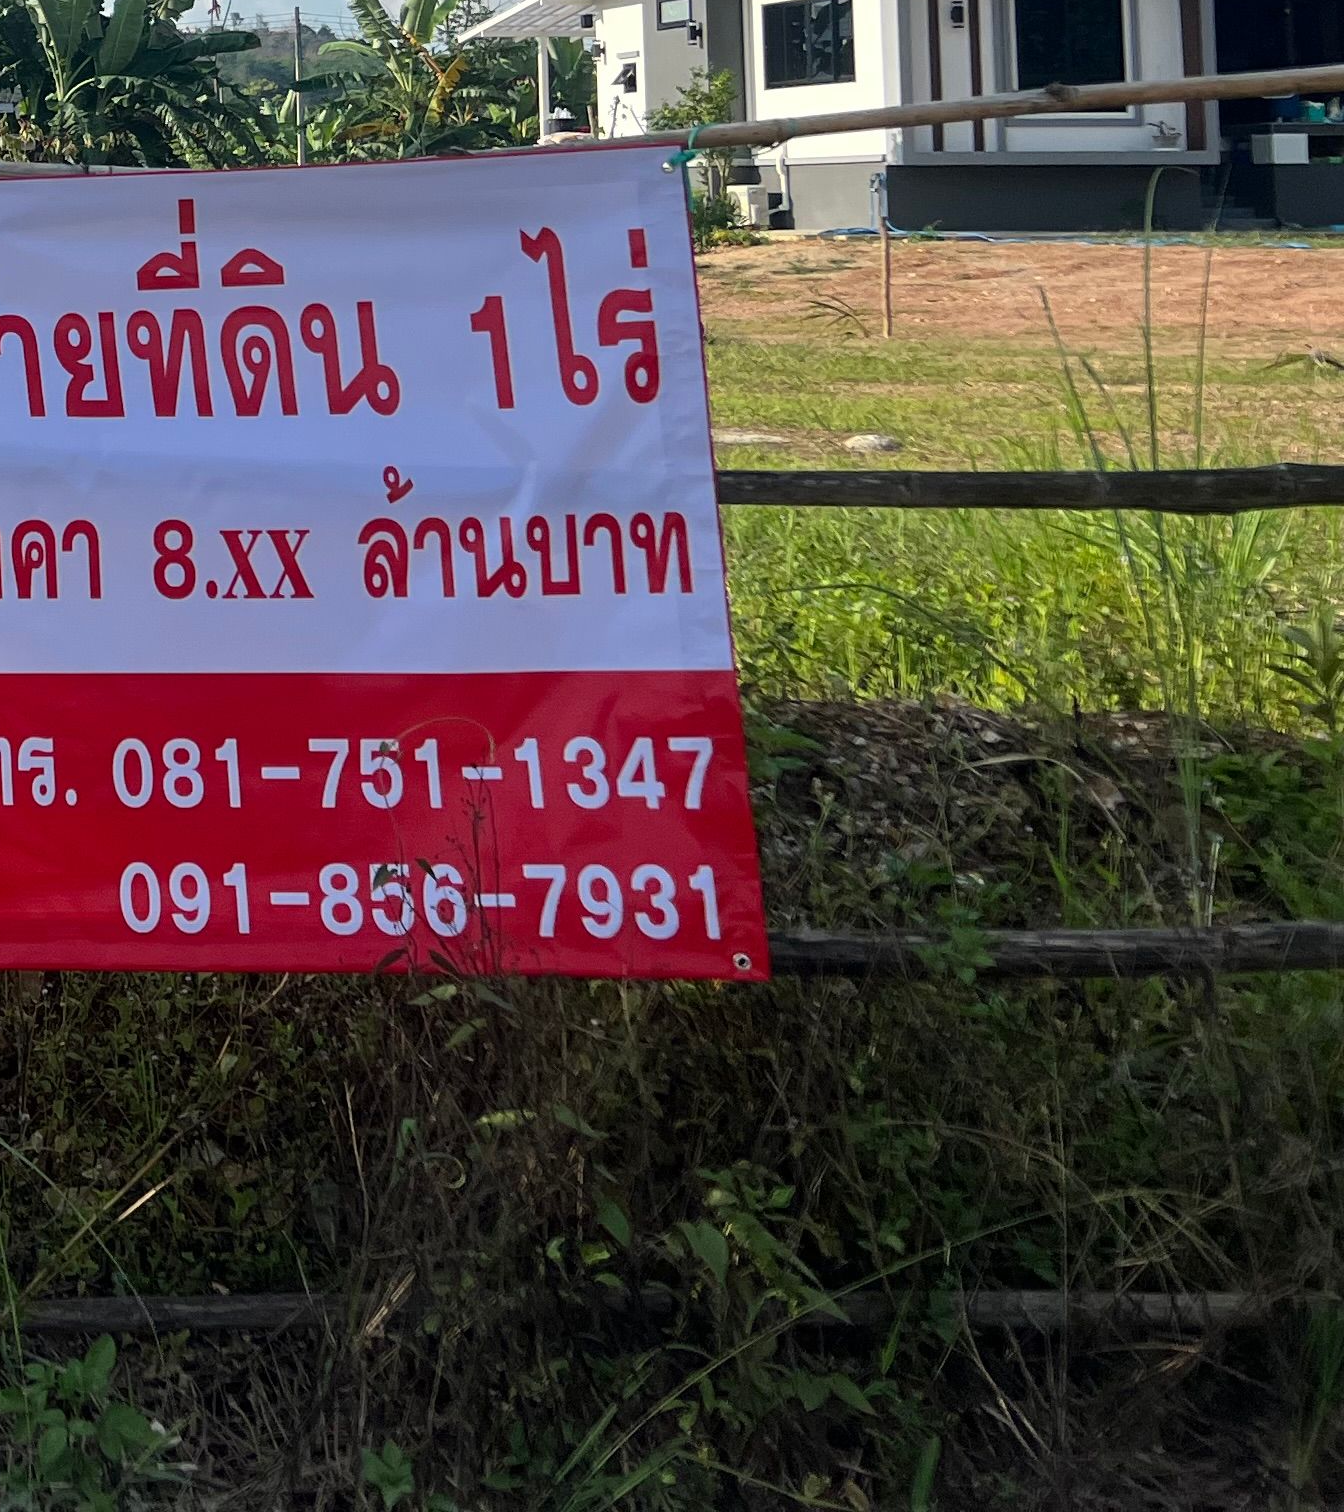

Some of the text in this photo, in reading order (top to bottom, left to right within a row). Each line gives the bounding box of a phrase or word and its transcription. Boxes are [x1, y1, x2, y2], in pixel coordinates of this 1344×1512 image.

[470, 226, 662, 411] 1ไร่
[358, 465, 693, 598] ล้านบาท
[113, 736, 714, 810] 081-751-1347
[120, 862, 722, 940] 091-856-7931
